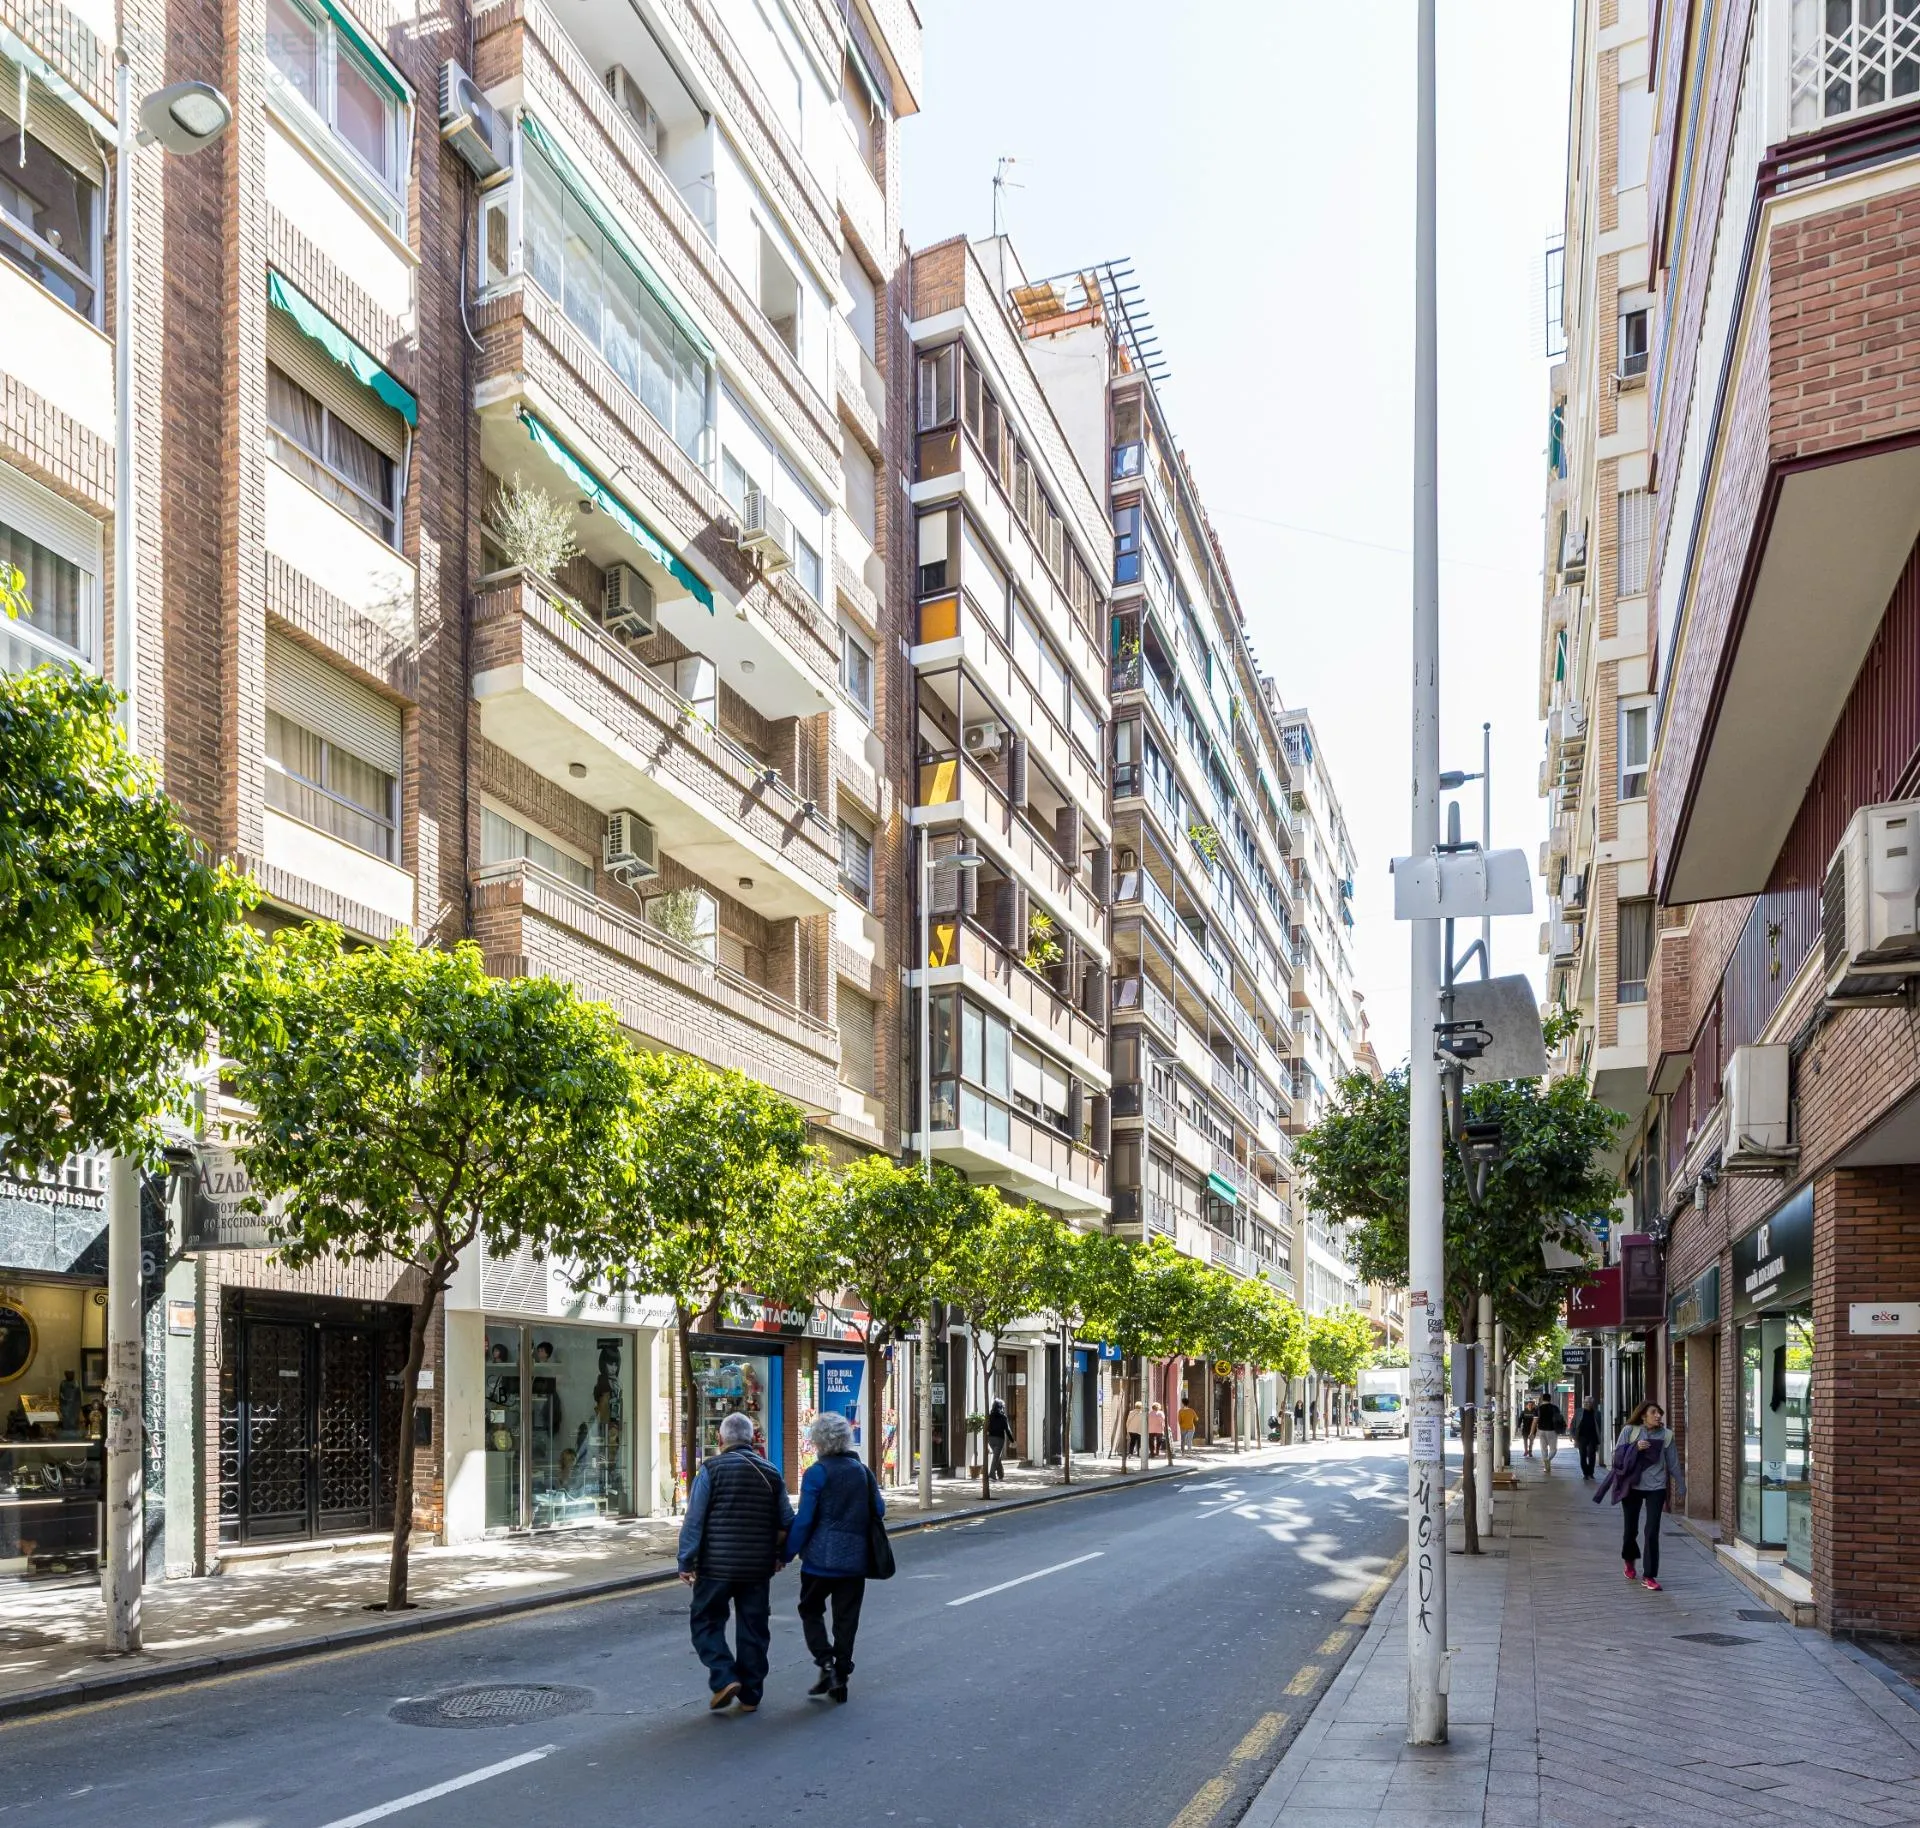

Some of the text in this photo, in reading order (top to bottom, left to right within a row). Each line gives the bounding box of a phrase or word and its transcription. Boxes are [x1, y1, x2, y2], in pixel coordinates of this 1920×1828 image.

[203, 1214, 282, 1231] COLECCIONISMO
[560, 1296, 586, 1309] Centro
[1871, 1311, 1900, 1321] e&a
[827, 1369, 853, 1378] RED BULL
[827, 1377, 843, 1385] TE DA
